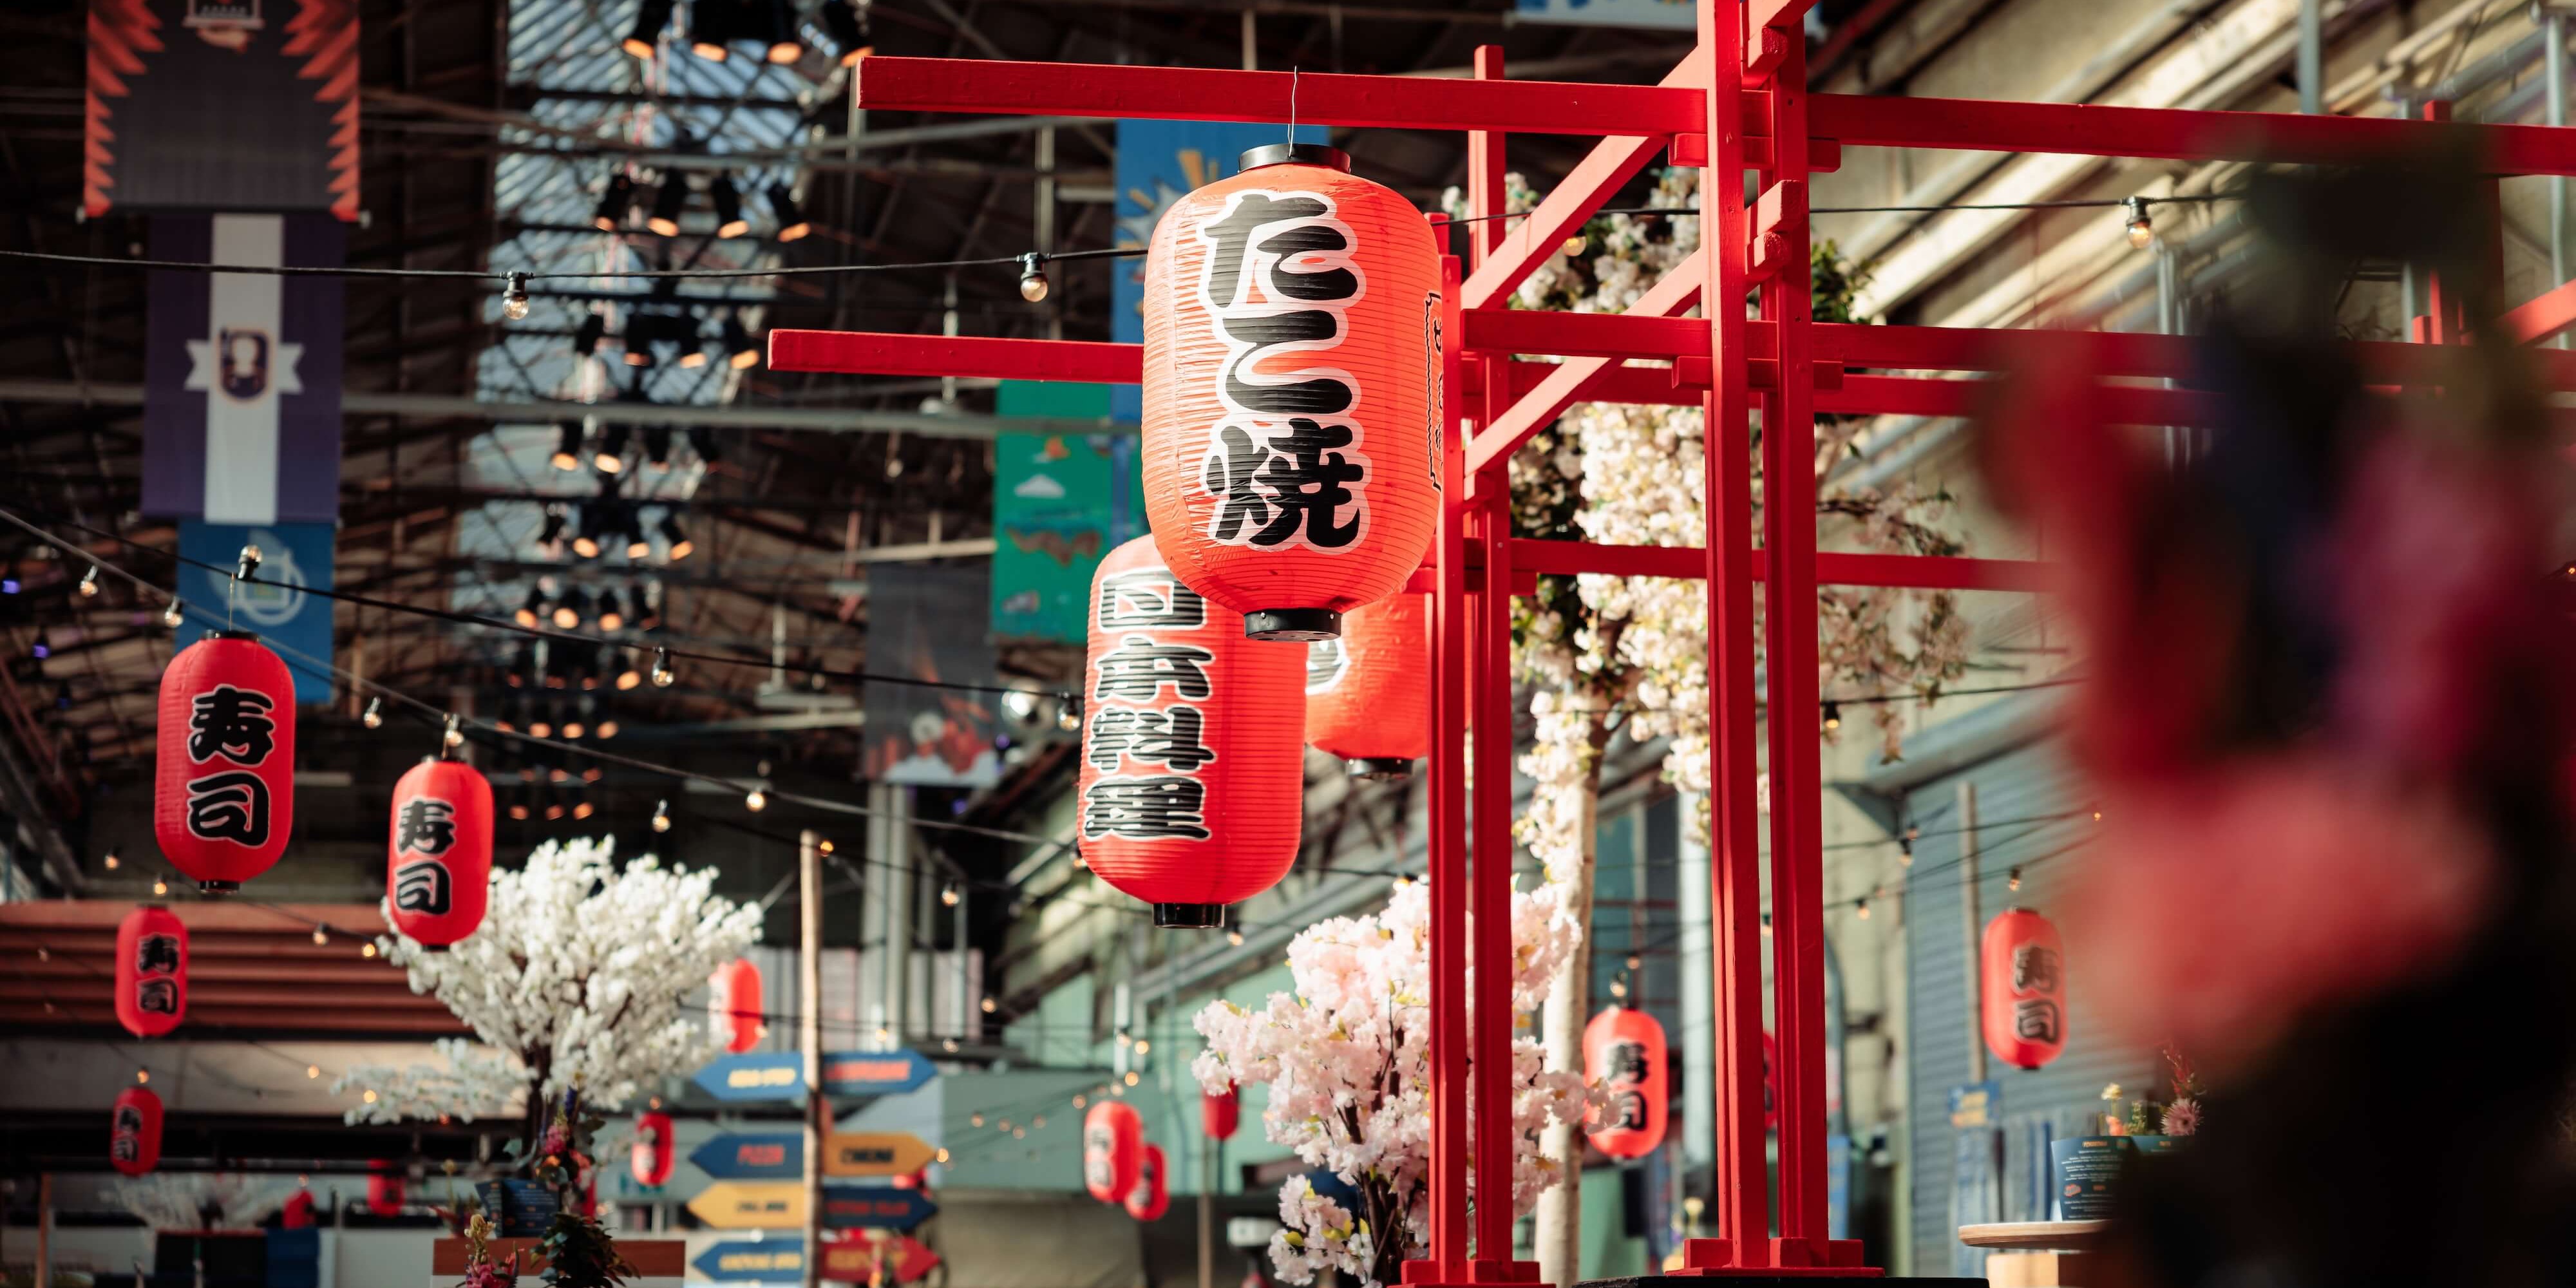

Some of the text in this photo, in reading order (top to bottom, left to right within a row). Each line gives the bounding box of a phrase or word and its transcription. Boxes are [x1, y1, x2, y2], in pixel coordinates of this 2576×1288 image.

[1202, 191, 1368, 550] たこ焼
[187, 683, 275, 849] 寿司
[1084, 569, 1216, 840] 日本料理
[396, 799, 455, 915] 寿司
[137, 933, 180, 1015] 寿司
[2013, 945, 2060, 1044] 寿司
